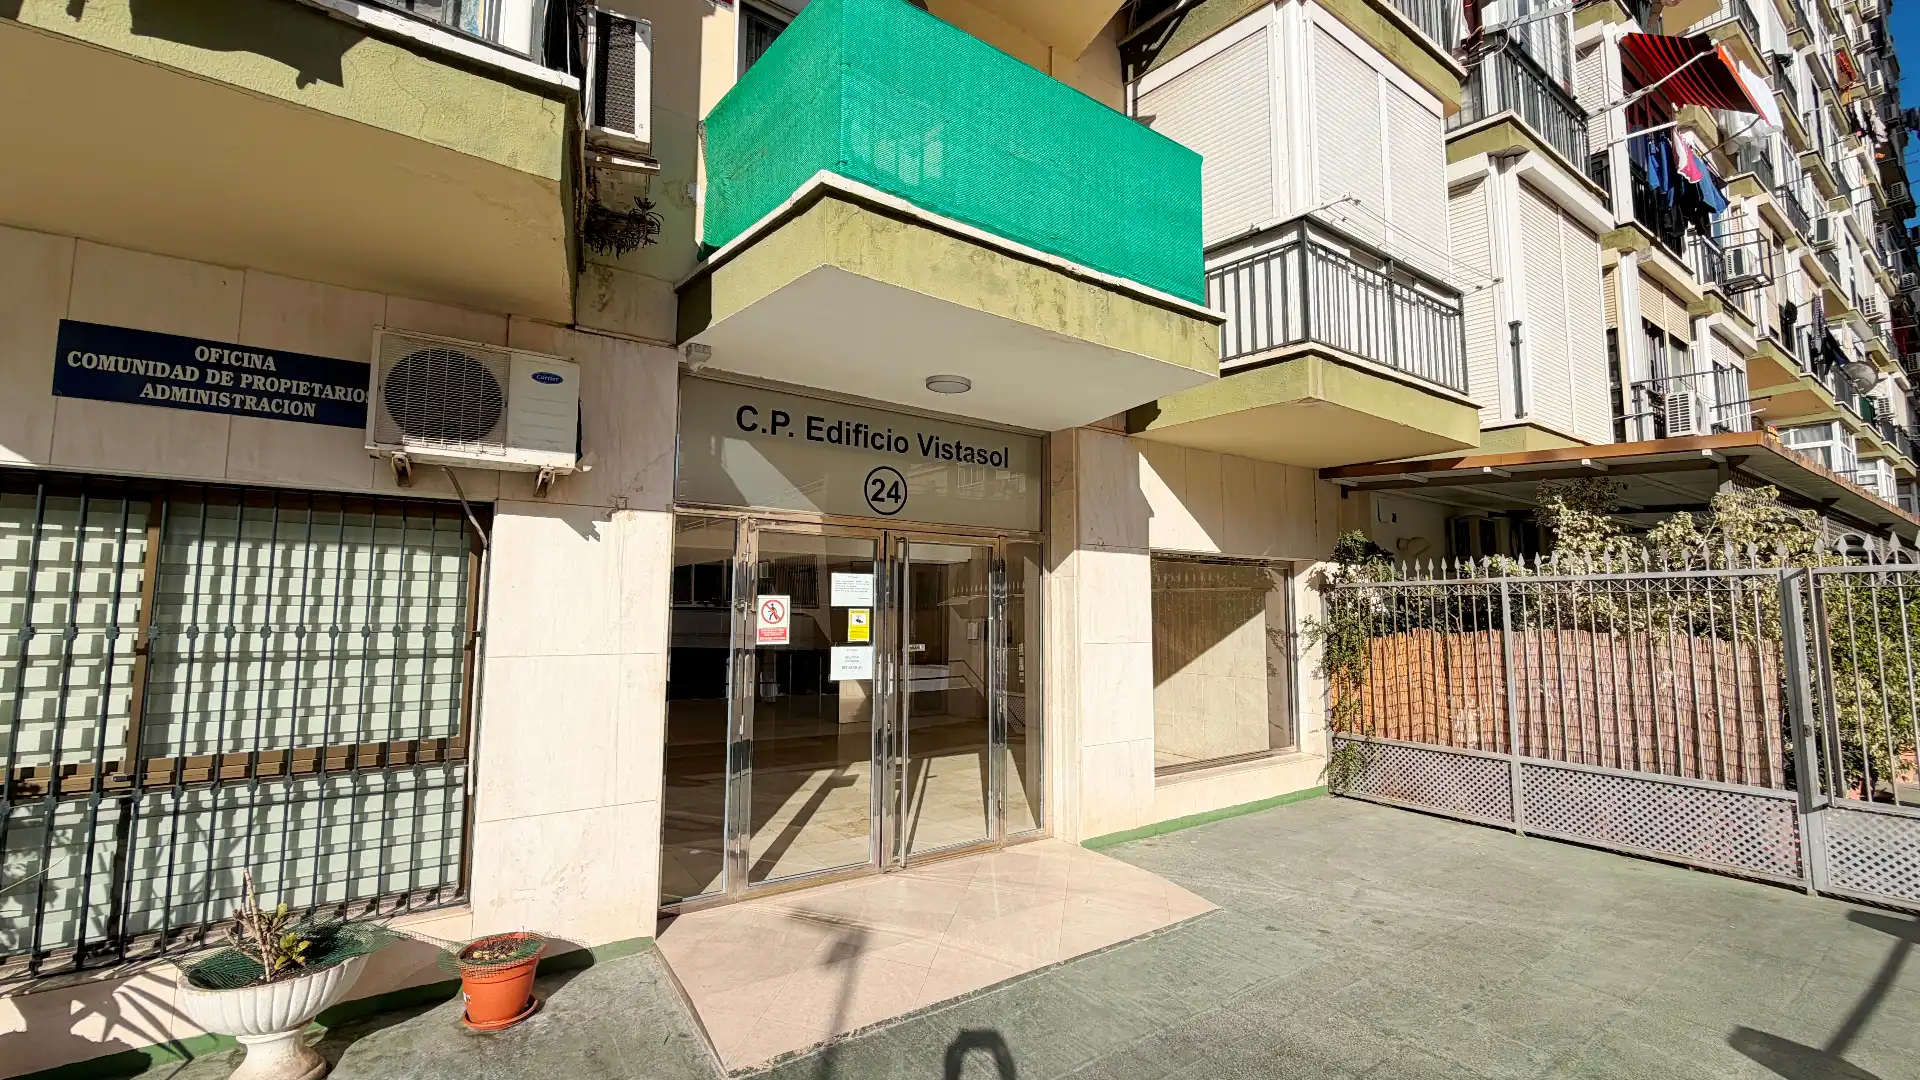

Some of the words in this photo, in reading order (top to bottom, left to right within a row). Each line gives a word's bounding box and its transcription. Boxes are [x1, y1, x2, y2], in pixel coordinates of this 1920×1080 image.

[67, 350, 200, 383] COMUNIDAD
[206, 368, 234, 387] DE
[195, 346, 277, 371] OFICINA
[140, 383, 316, 419] ADMINISTRACION
[737, 404, 794, 438] C.P.
[807, 415, 909, 456] Edificio
[917, 432, 1009, 469] Vistasol
[871, 478, 902, 504] 24
